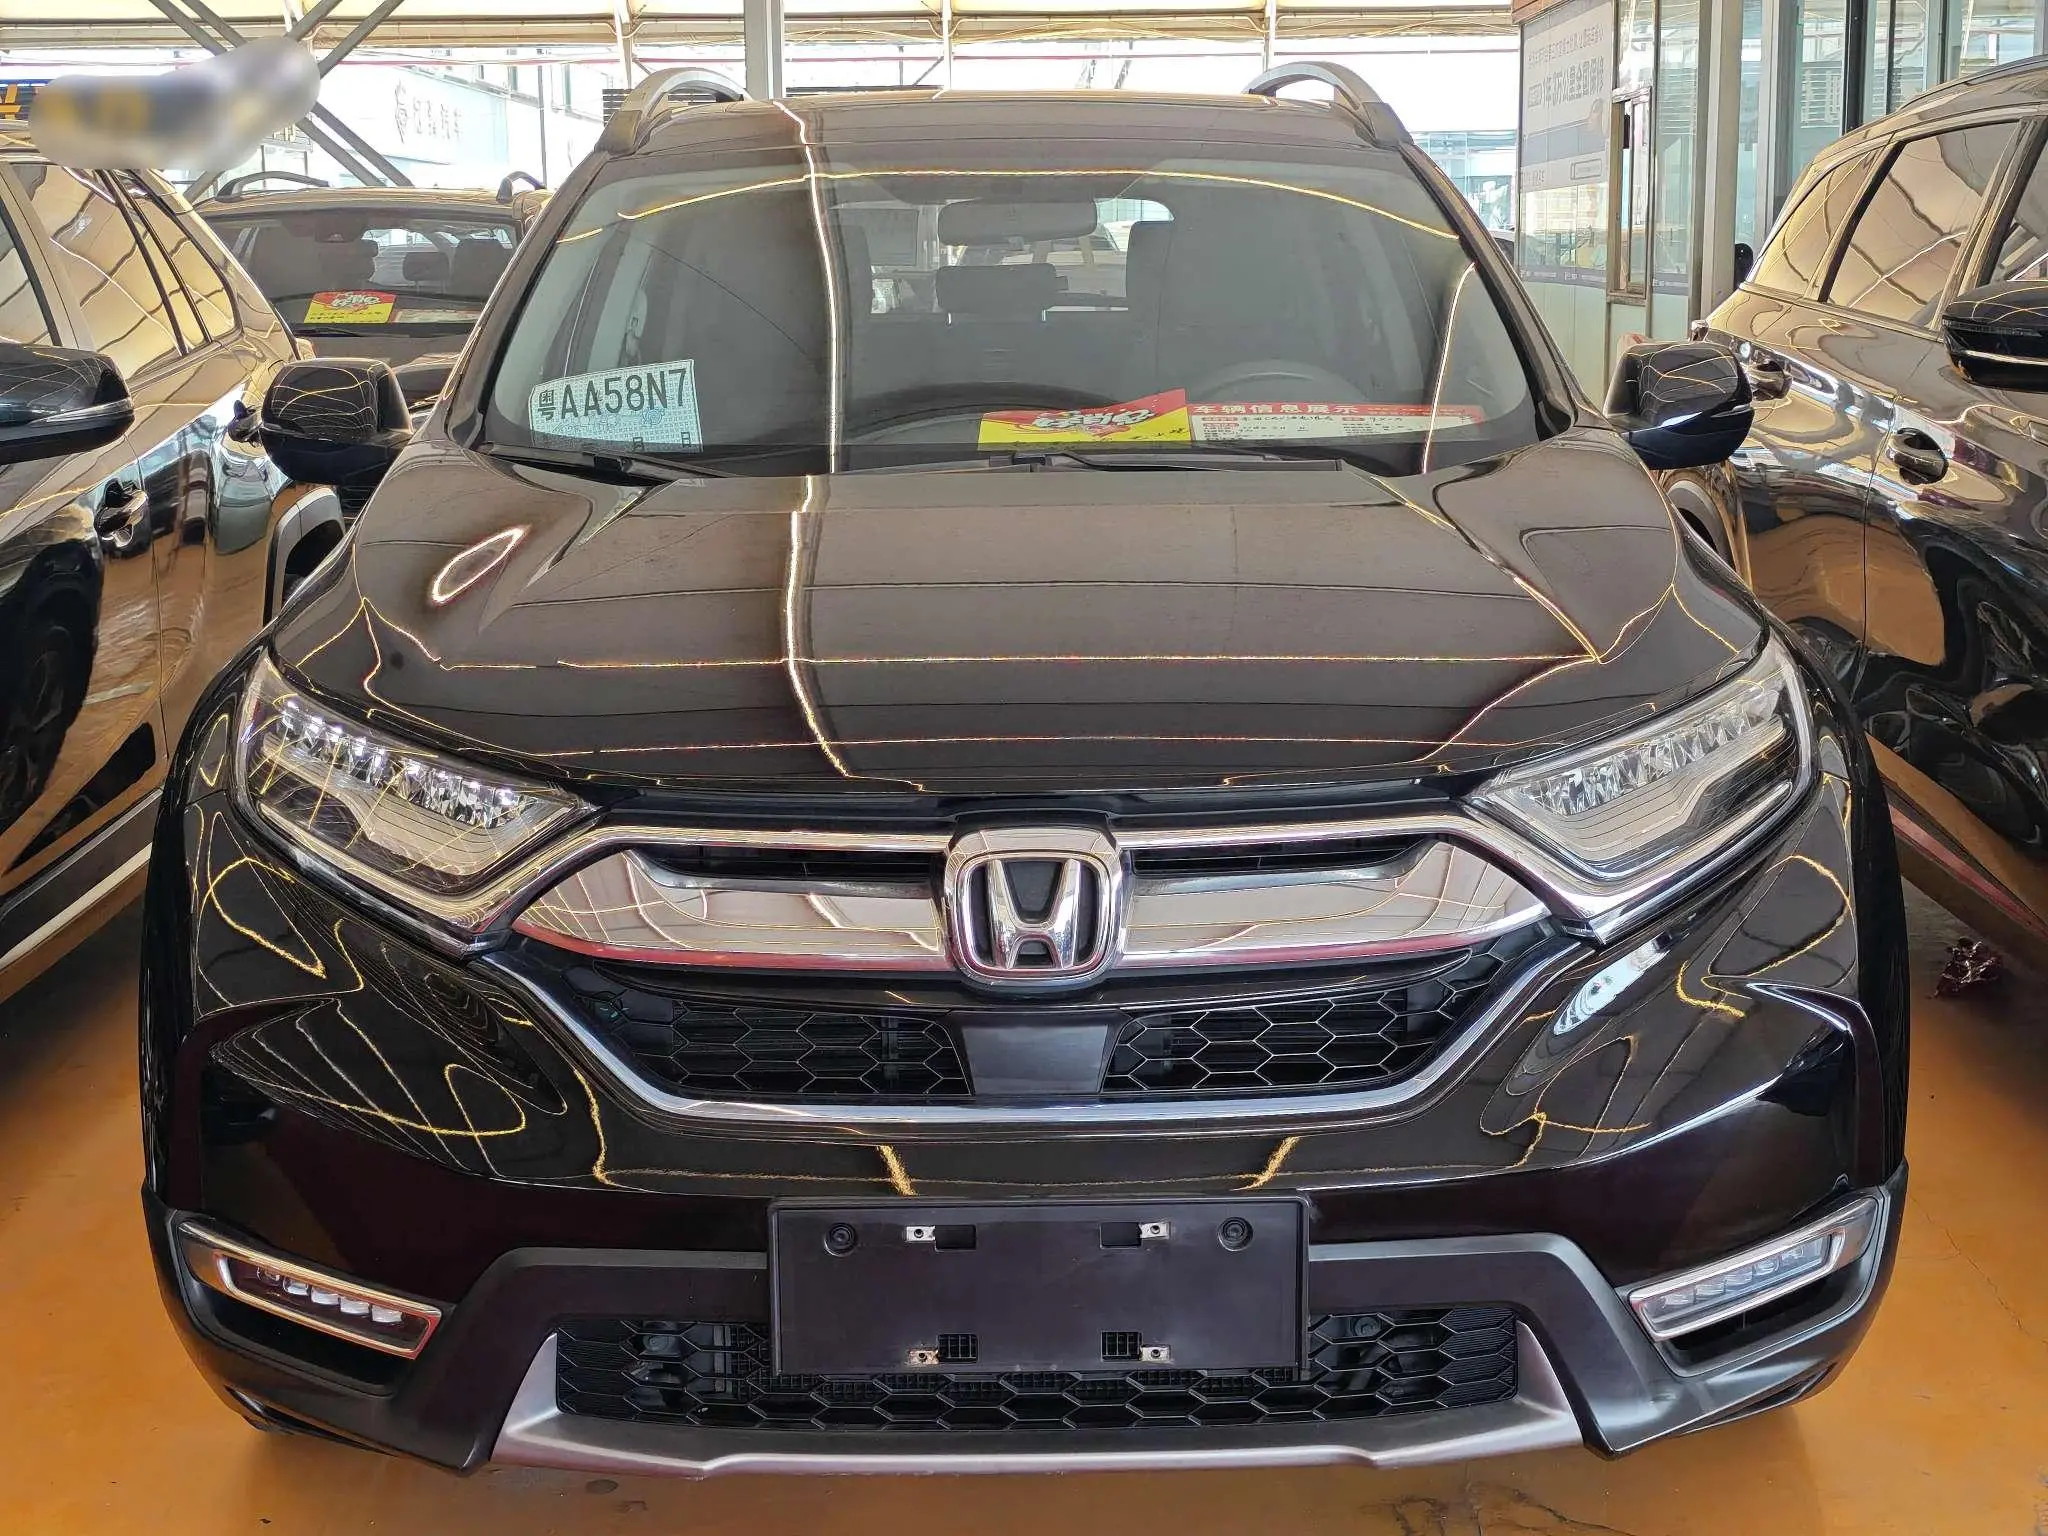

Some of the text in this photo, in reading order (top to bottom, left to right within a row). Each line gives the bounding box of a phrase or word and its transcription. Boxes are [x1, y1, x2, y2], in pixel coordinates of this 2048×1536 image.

[537, 368, 687, 421] 粤AA58N7
[1195, 404, 1359, 415] 车辆信息展示
